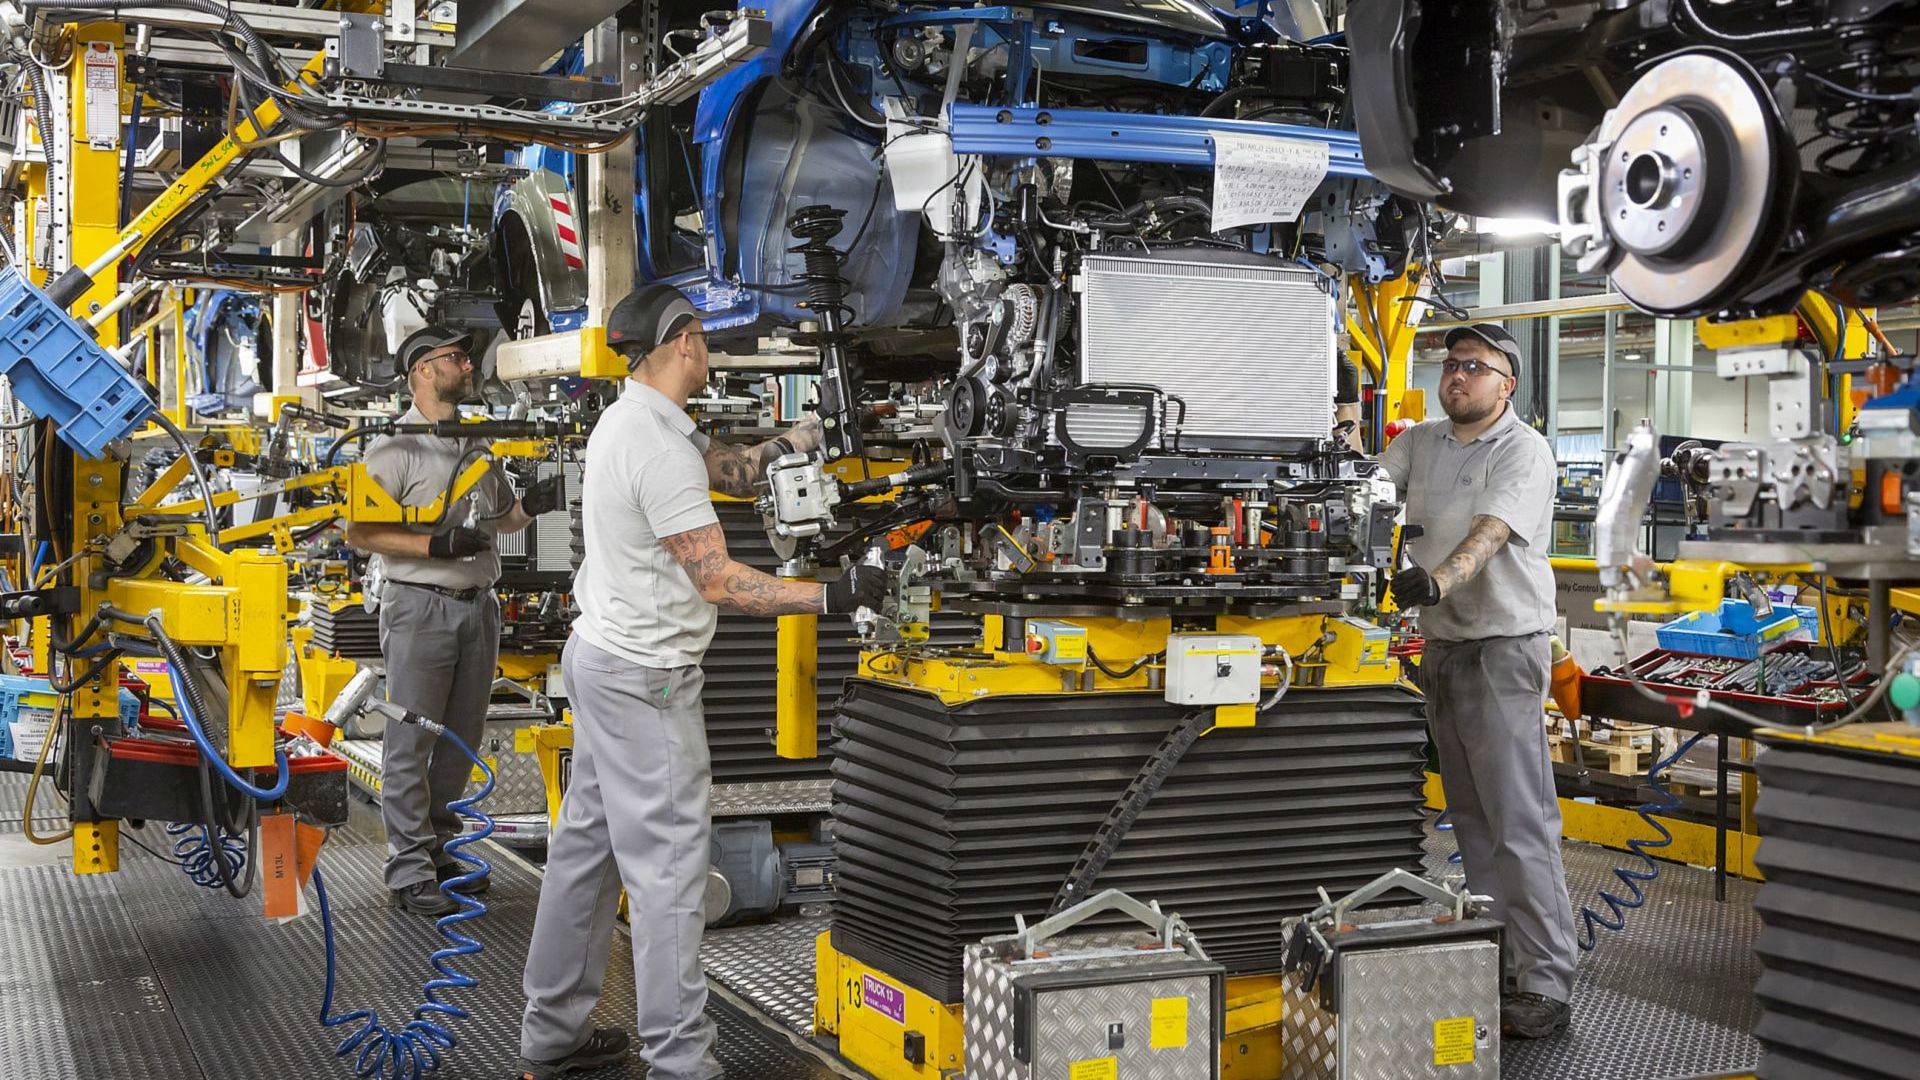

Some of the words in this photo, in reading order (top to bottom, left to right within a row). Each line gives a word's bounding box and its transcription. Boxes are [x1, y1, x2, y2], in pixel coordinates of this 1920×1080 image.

[1572, 582, 1599, 593] Control
[846, 977, 862, 1009] 13
[864, 977, 886, 999] TRUCK
